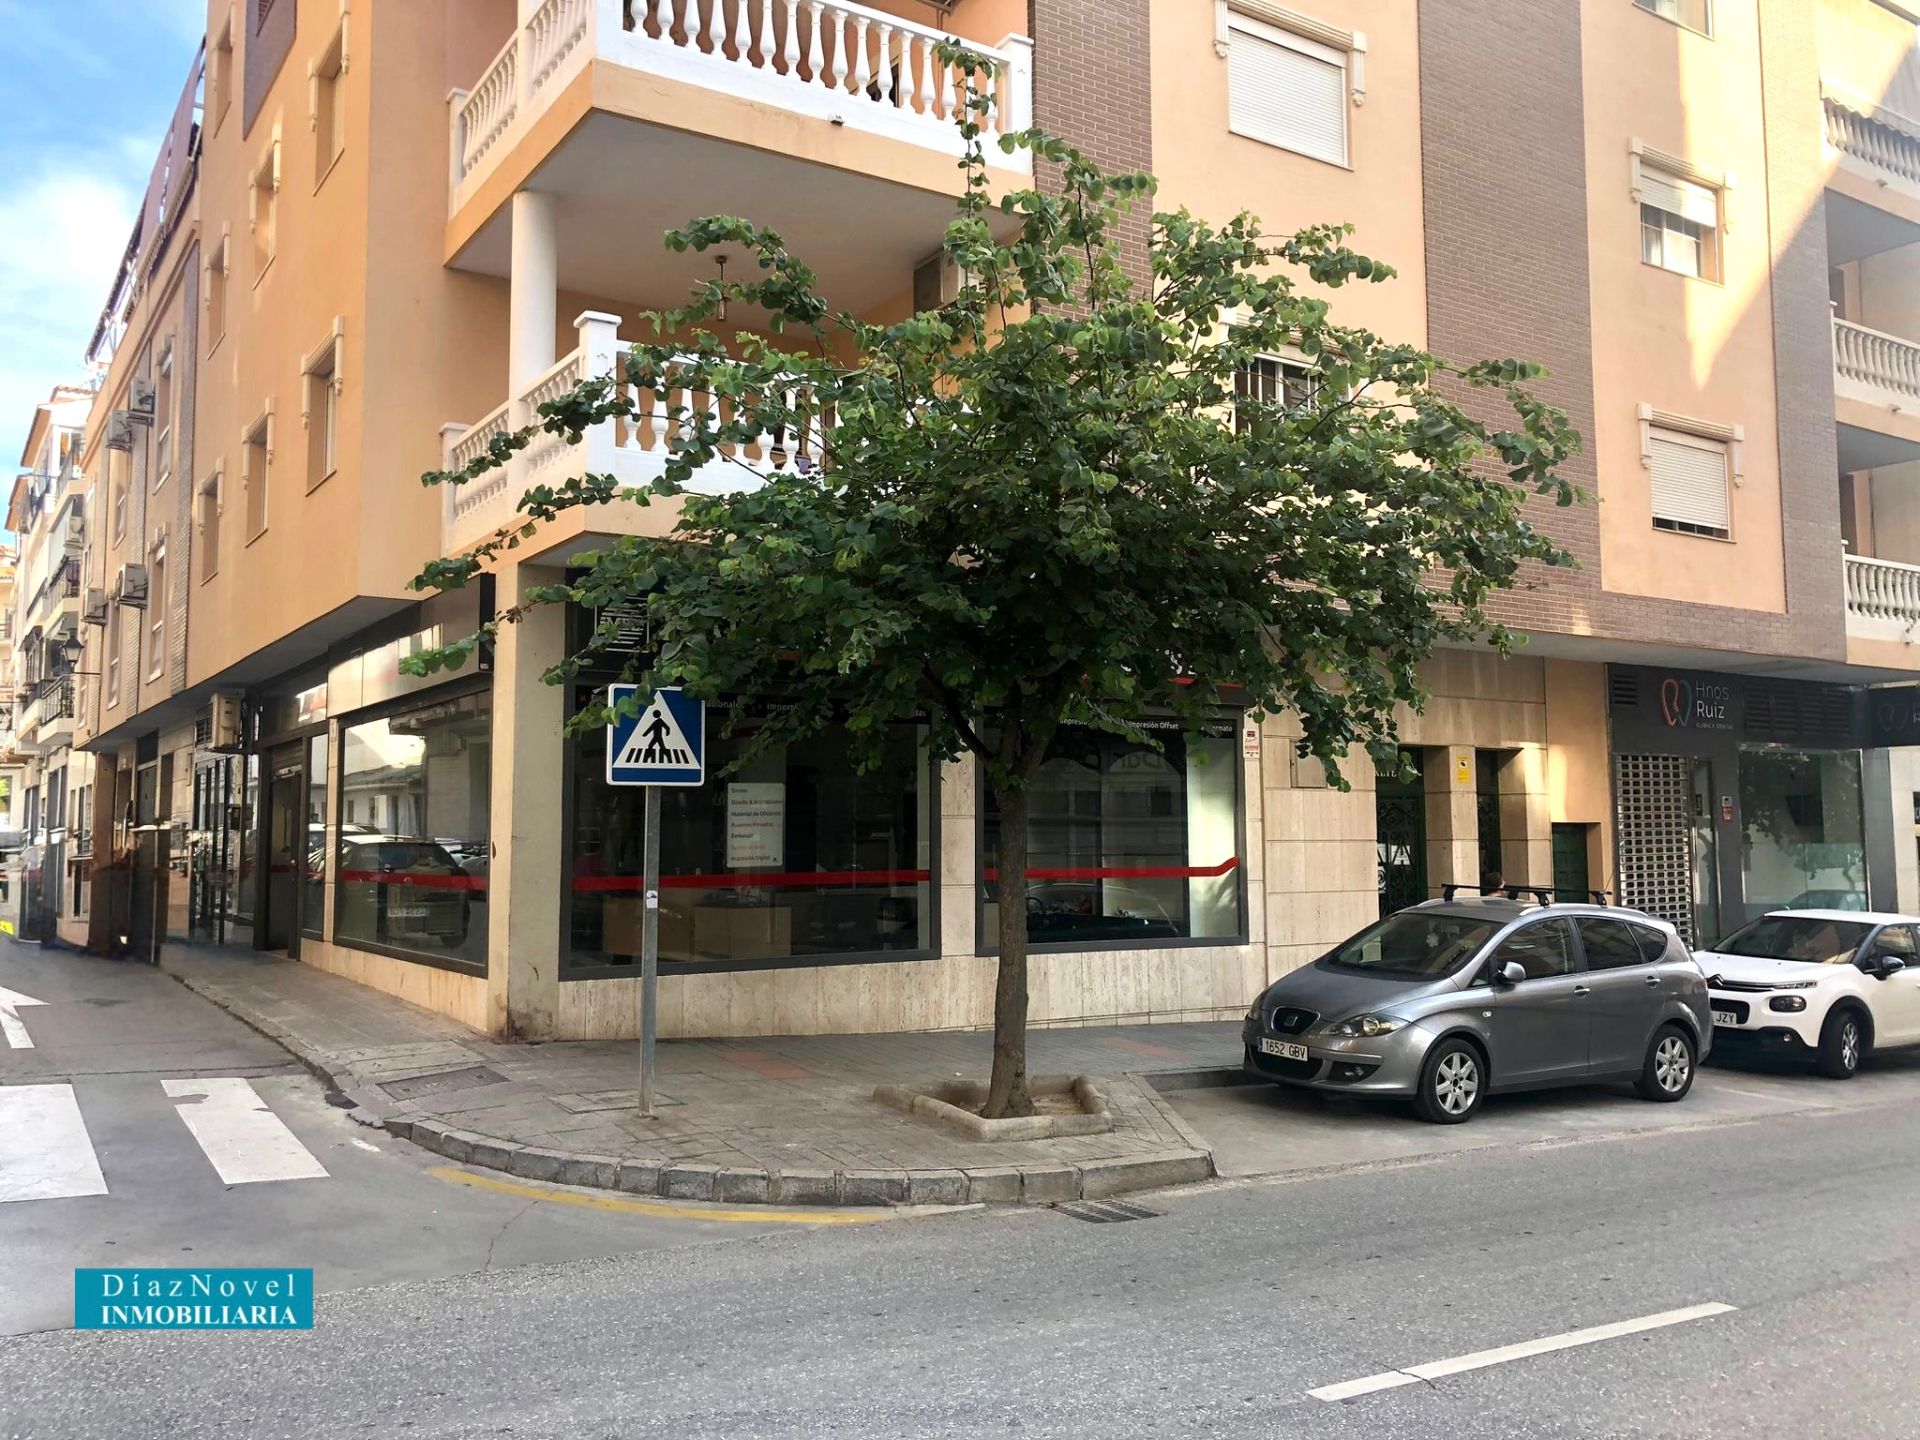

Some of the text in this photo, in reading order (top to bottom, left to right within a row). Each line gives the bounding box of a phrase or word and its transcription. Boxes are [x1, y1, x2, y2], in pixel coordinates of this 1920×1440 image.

[1695, 679, 1730, 700] Hnos
[1696, 699, 1725, 719] Ruiz
[1160, 720, 1179, 730] Offset
[1715, 1012, 1735, 1024] JZY
[1265, 1040, 1306, 1059] 1652 GBV
